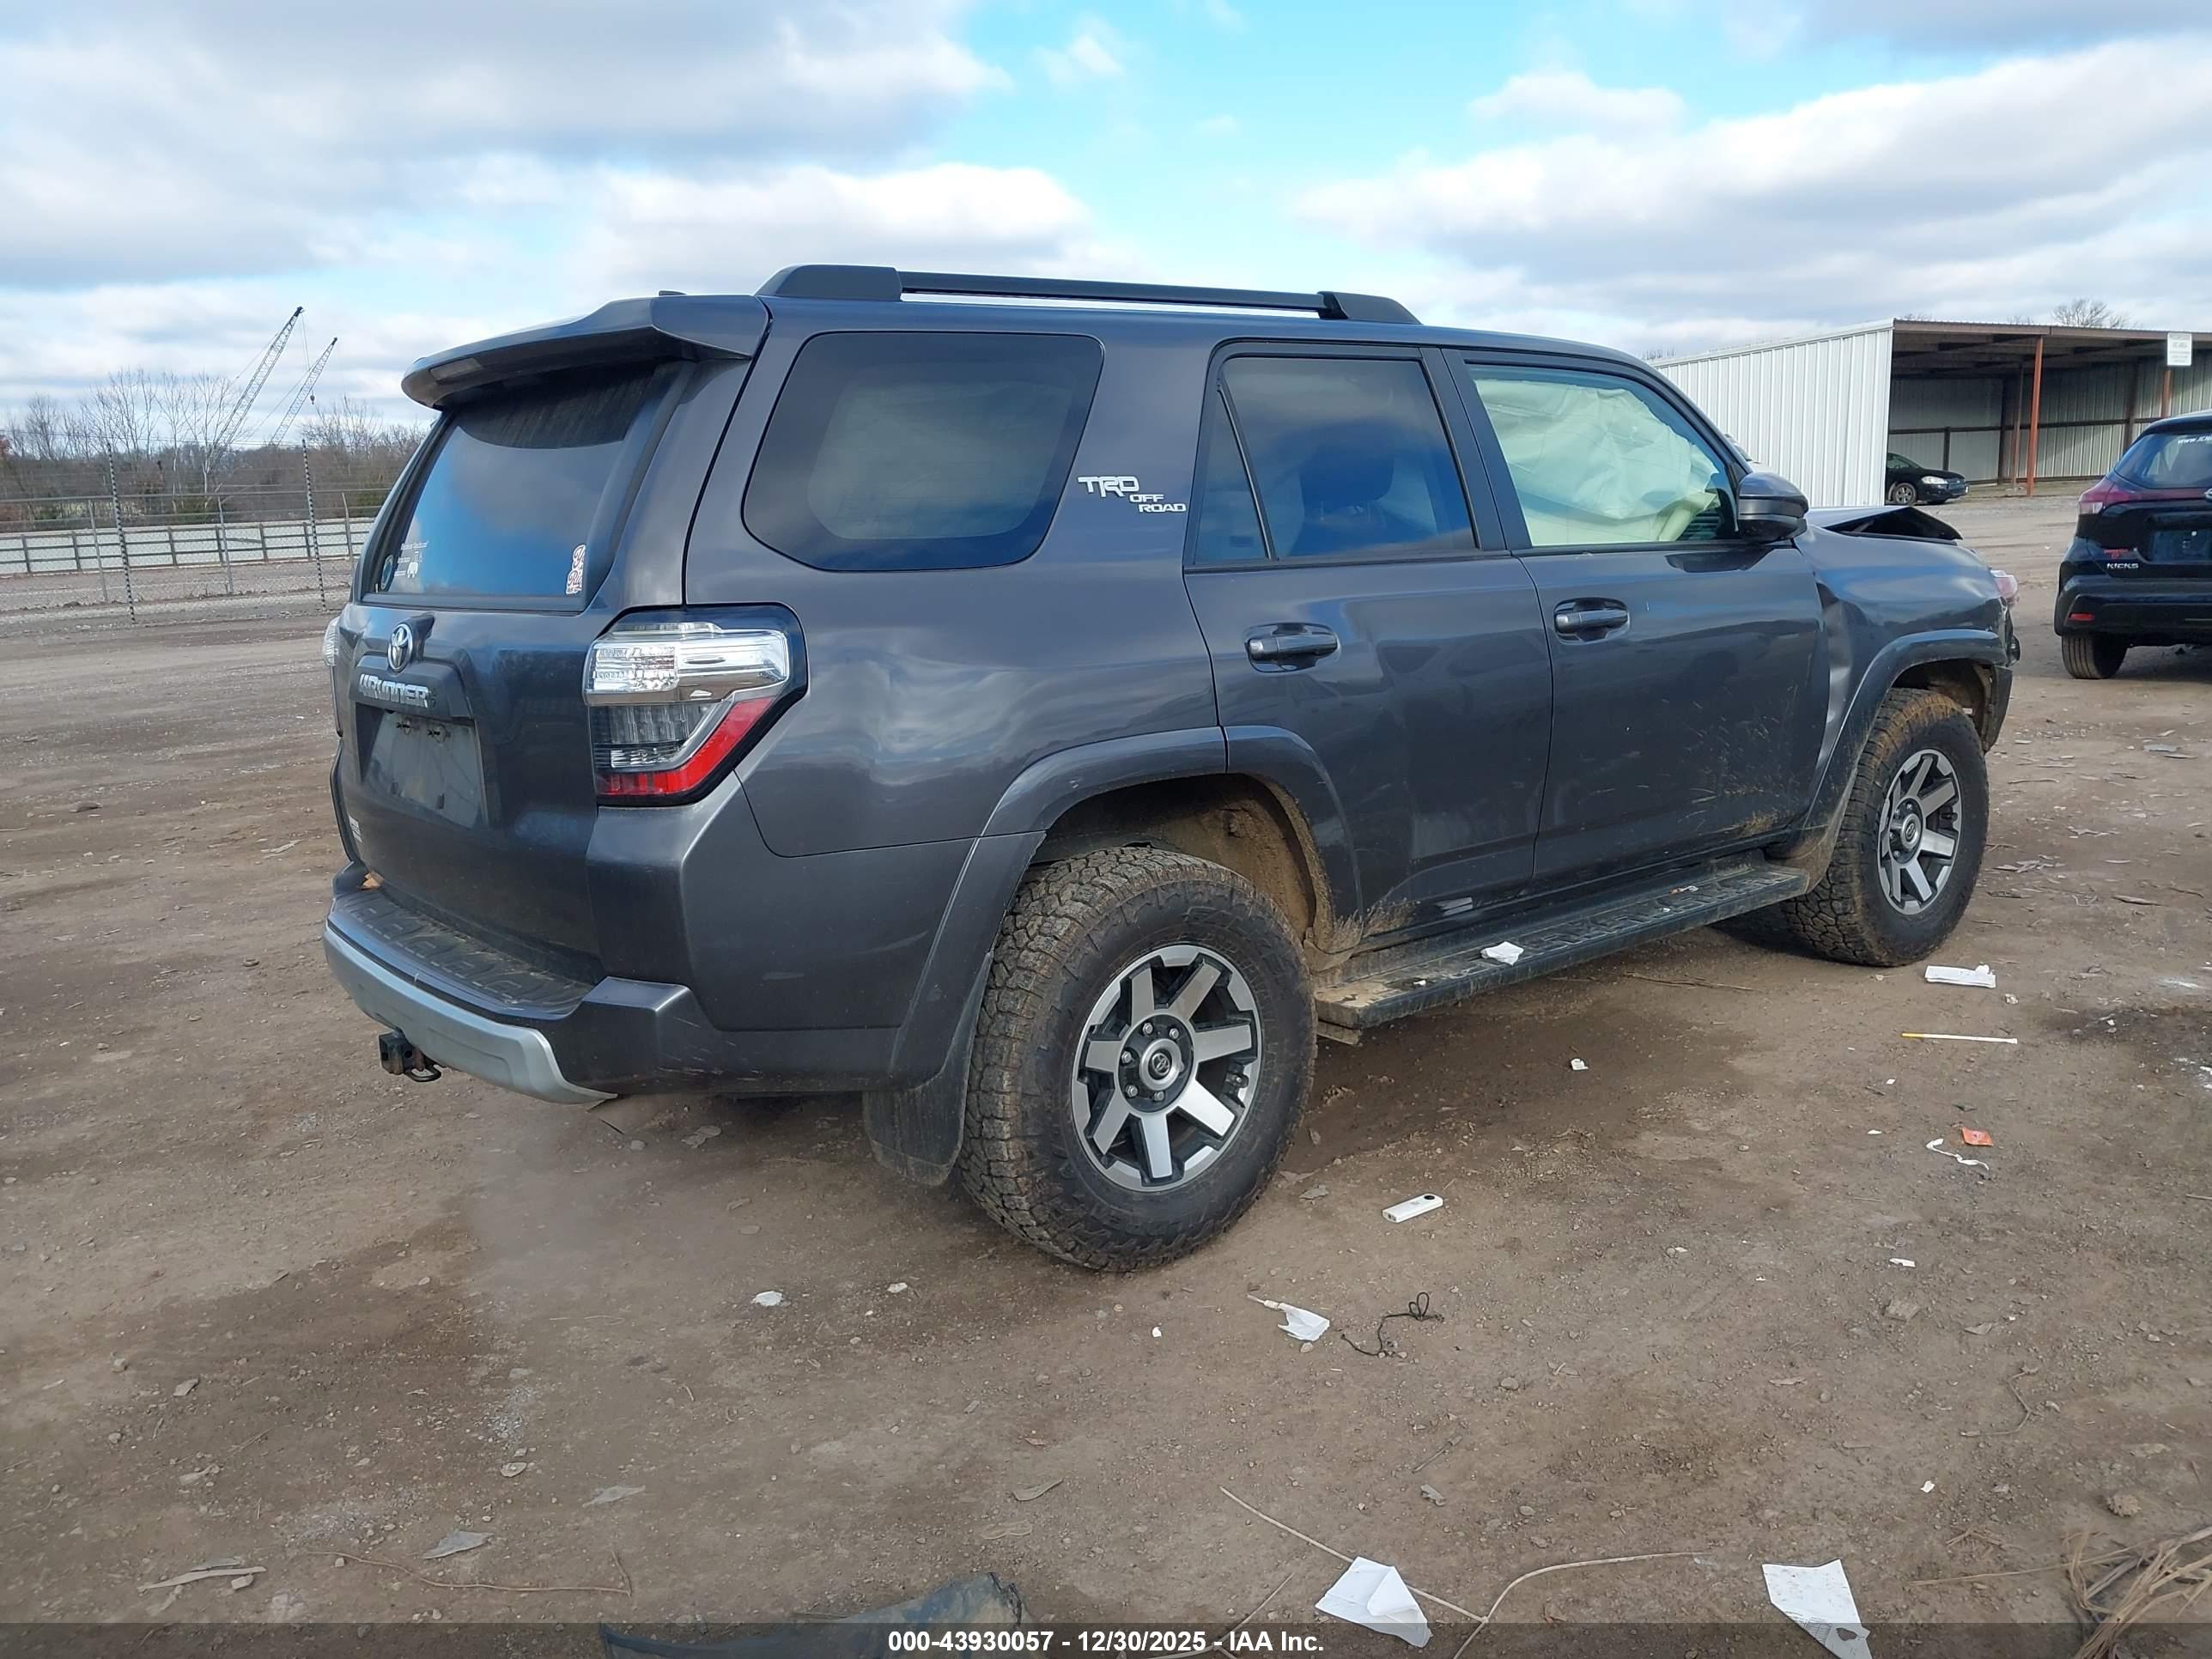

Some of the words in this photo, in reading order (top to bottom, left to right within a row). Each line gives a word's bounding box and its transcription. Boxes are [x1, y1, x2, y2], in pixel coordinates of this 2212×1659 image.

[1077, 476, 1140, 498] TRD
[1129, 494, 1164, 503] OFF
[1138, 503, 1187, 514] ROAD
